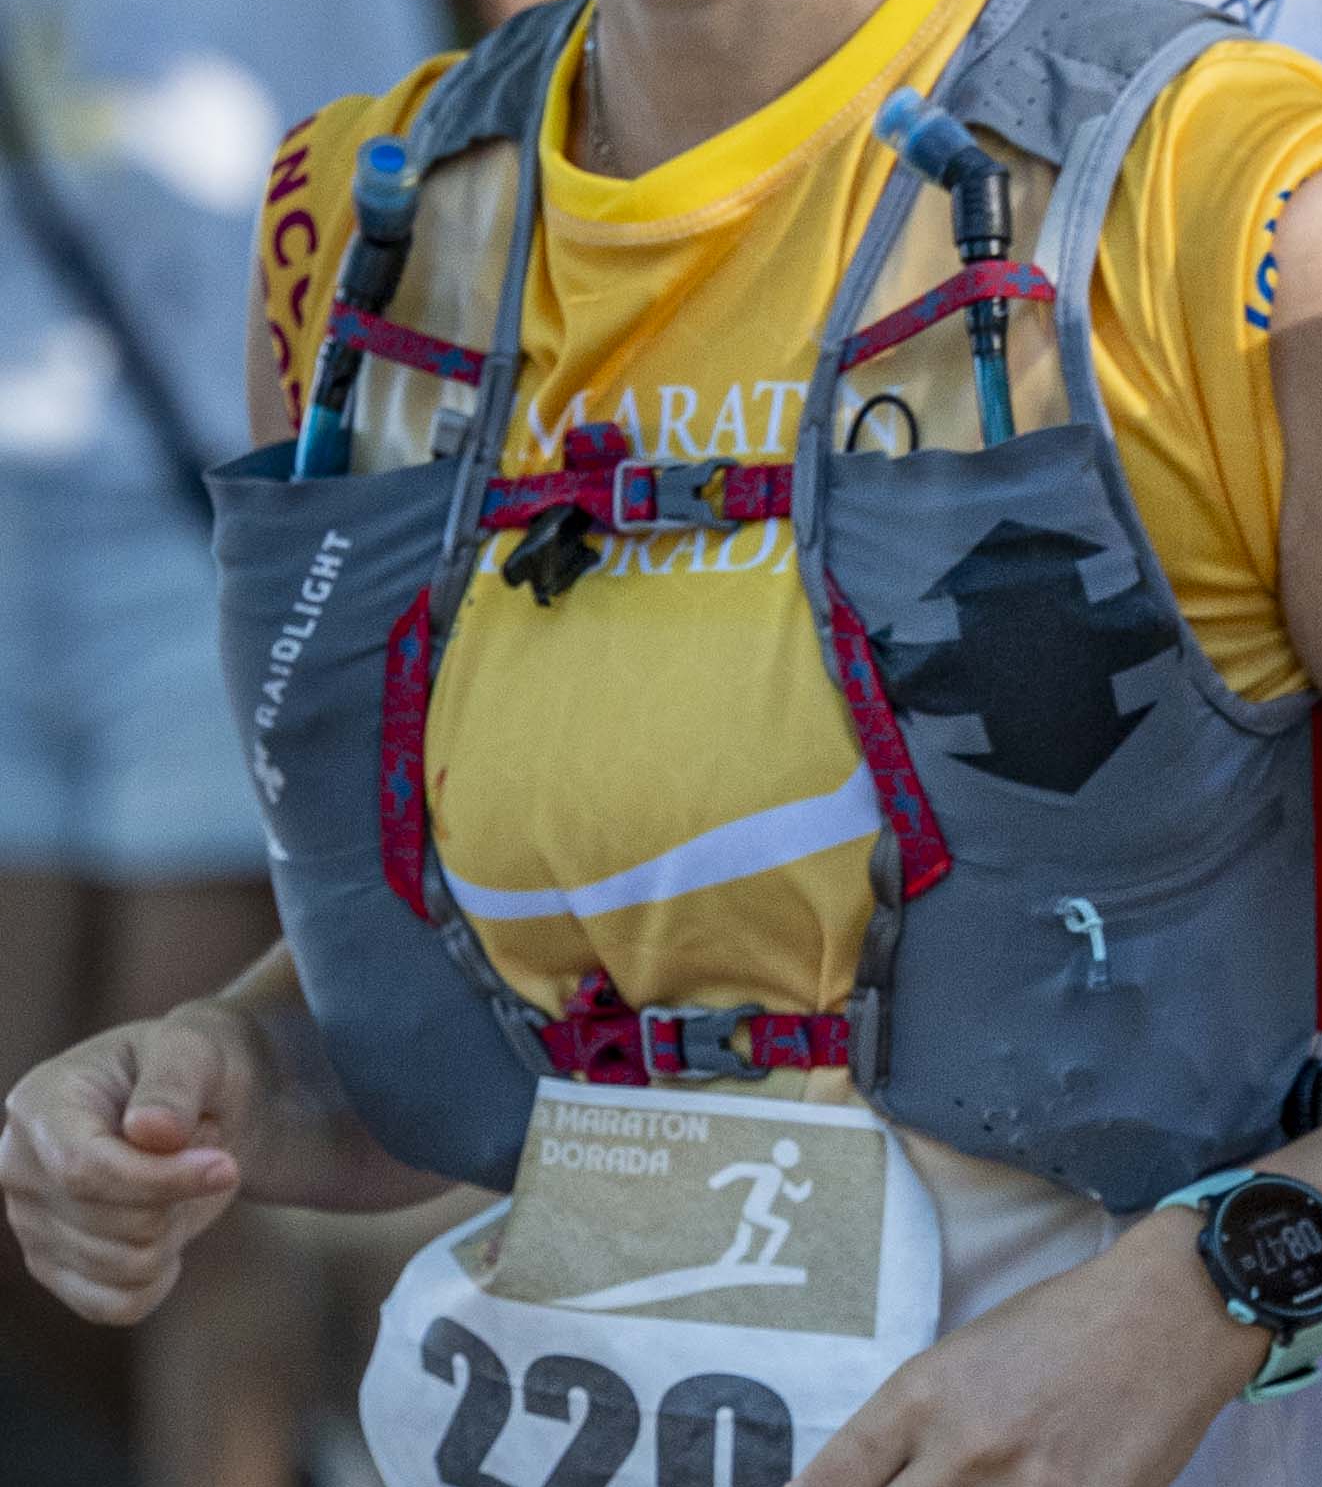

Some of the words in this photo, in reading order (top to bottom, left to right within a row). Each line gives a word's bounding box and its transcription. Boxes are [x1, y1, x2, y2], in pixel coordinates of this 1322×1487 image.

[517, 379, 904, 462] MARATN
[254, 527, 353, 730] RAIDLIGHT
[540, 1137, 672, 1176] DORADA
